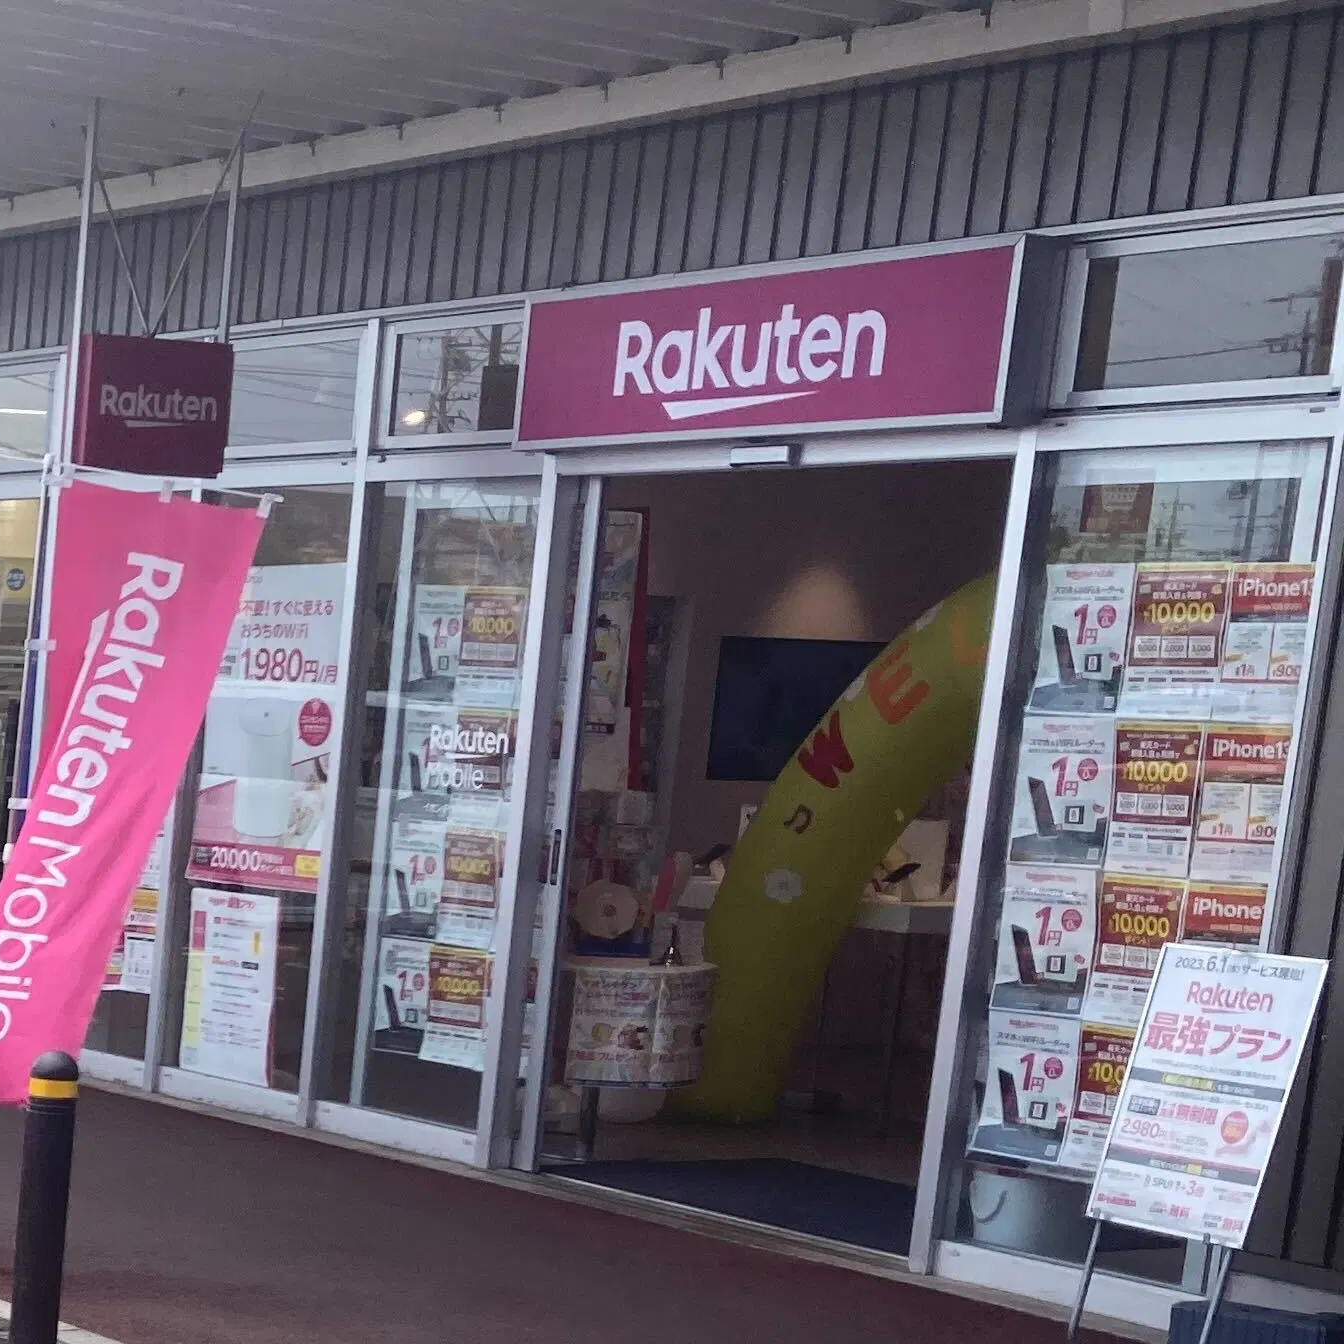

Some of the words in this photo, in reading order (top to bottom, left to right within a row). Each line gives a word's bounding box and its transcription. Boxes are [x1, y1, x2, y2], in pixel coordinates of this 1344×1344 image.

[612, 303, 888, 398] Rakuten
[100, 384, 217, 422] Rakuten
[30, 552, 184, 830] Rakuten
[430, 725, 509, 754] Rakuten
[425, 763, 484, 789] Mobile
[1193, 896, 1266, 919] iPhone
[1186, 980, 1274, 1013] Rakuten
[1144, 1012, 1292, 1062] 最強プラン
